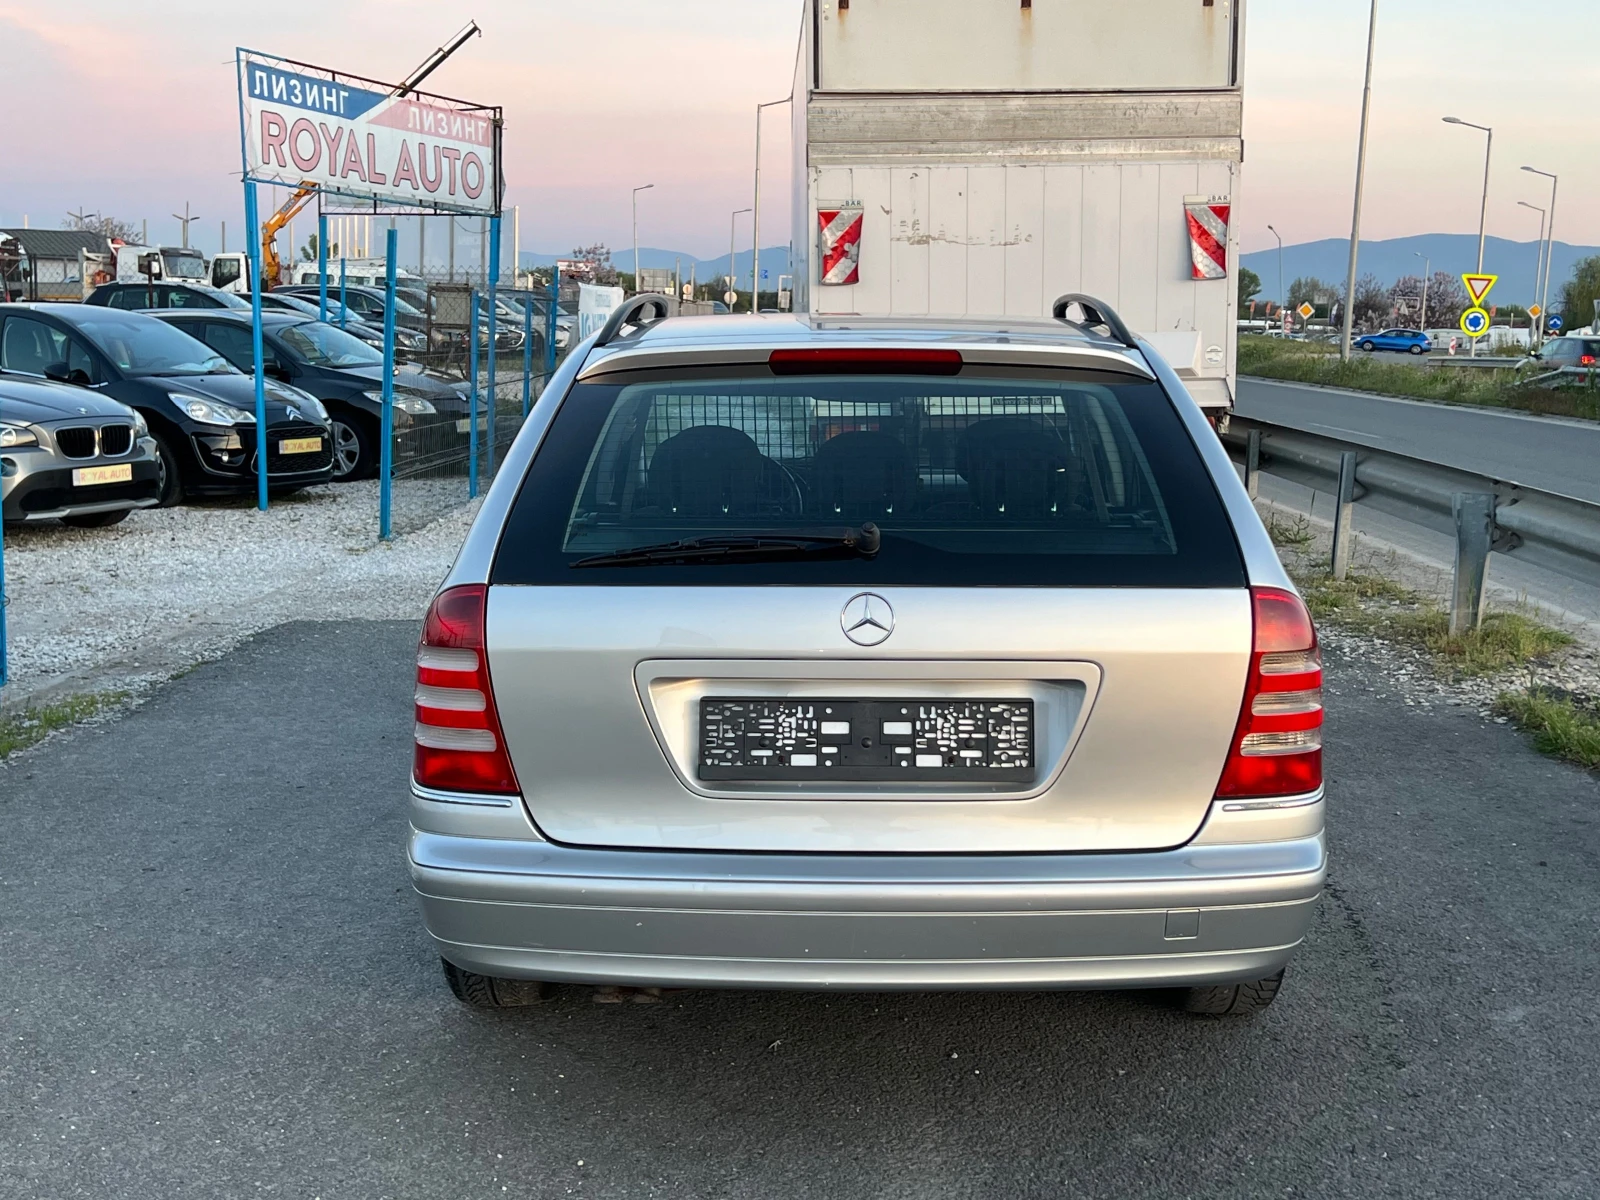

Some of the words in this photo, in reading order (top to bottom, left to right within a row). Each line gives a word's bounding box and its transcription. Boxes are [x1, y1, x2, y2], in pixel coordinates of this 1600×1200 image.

[254, 70, 349, 114] ЛИЗИНГ
[408, 106, 487, 142] ЛИЗИНГ
[261, 110, 387, 185] ROYAL
[392, 138, 485, 200] AUTO
[284, 441, 305, 452] RYAL
[110, 468, 131, 479] AUTO
